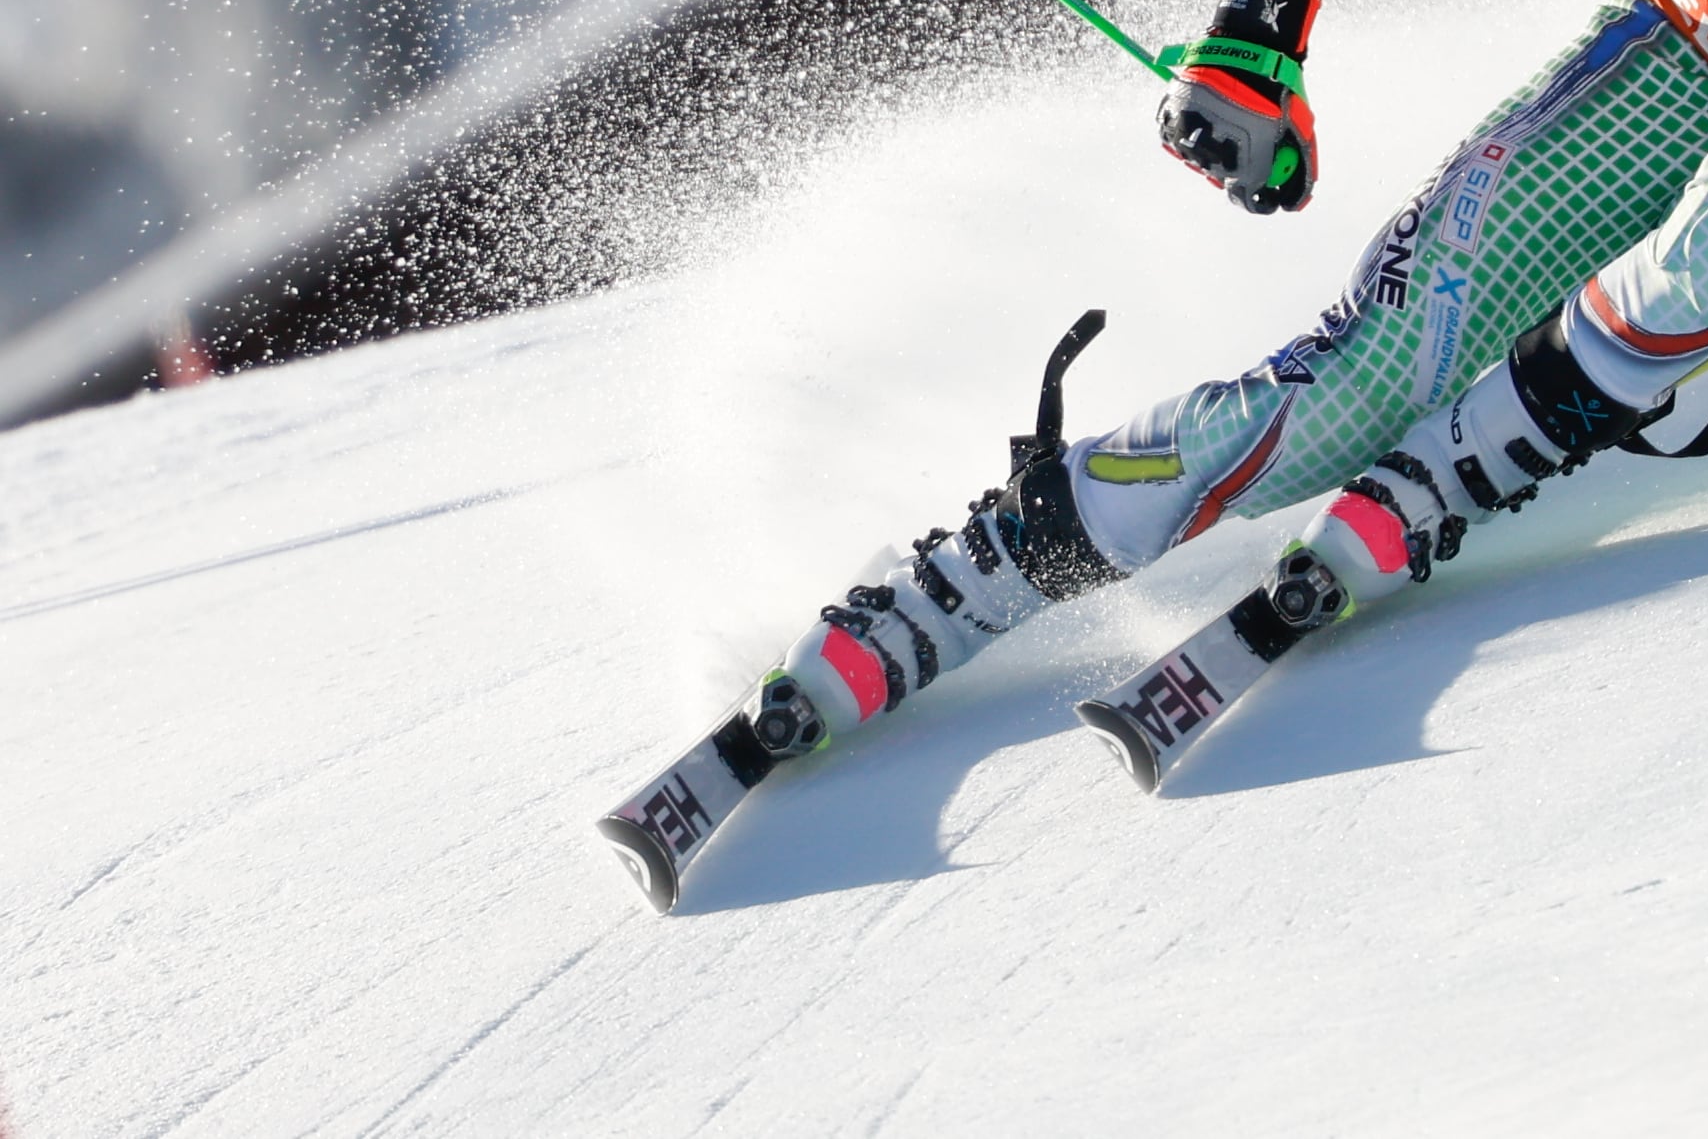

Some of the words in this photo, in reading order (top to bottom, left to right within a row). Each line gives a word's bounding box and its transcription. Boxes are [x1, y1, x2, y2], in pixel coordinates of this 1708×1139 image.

[1427, 305, 1461, 404] GRANDVALIRA
[1119, 652, 1224, 757] HEA
[638, 772, 712, 858] HEA
